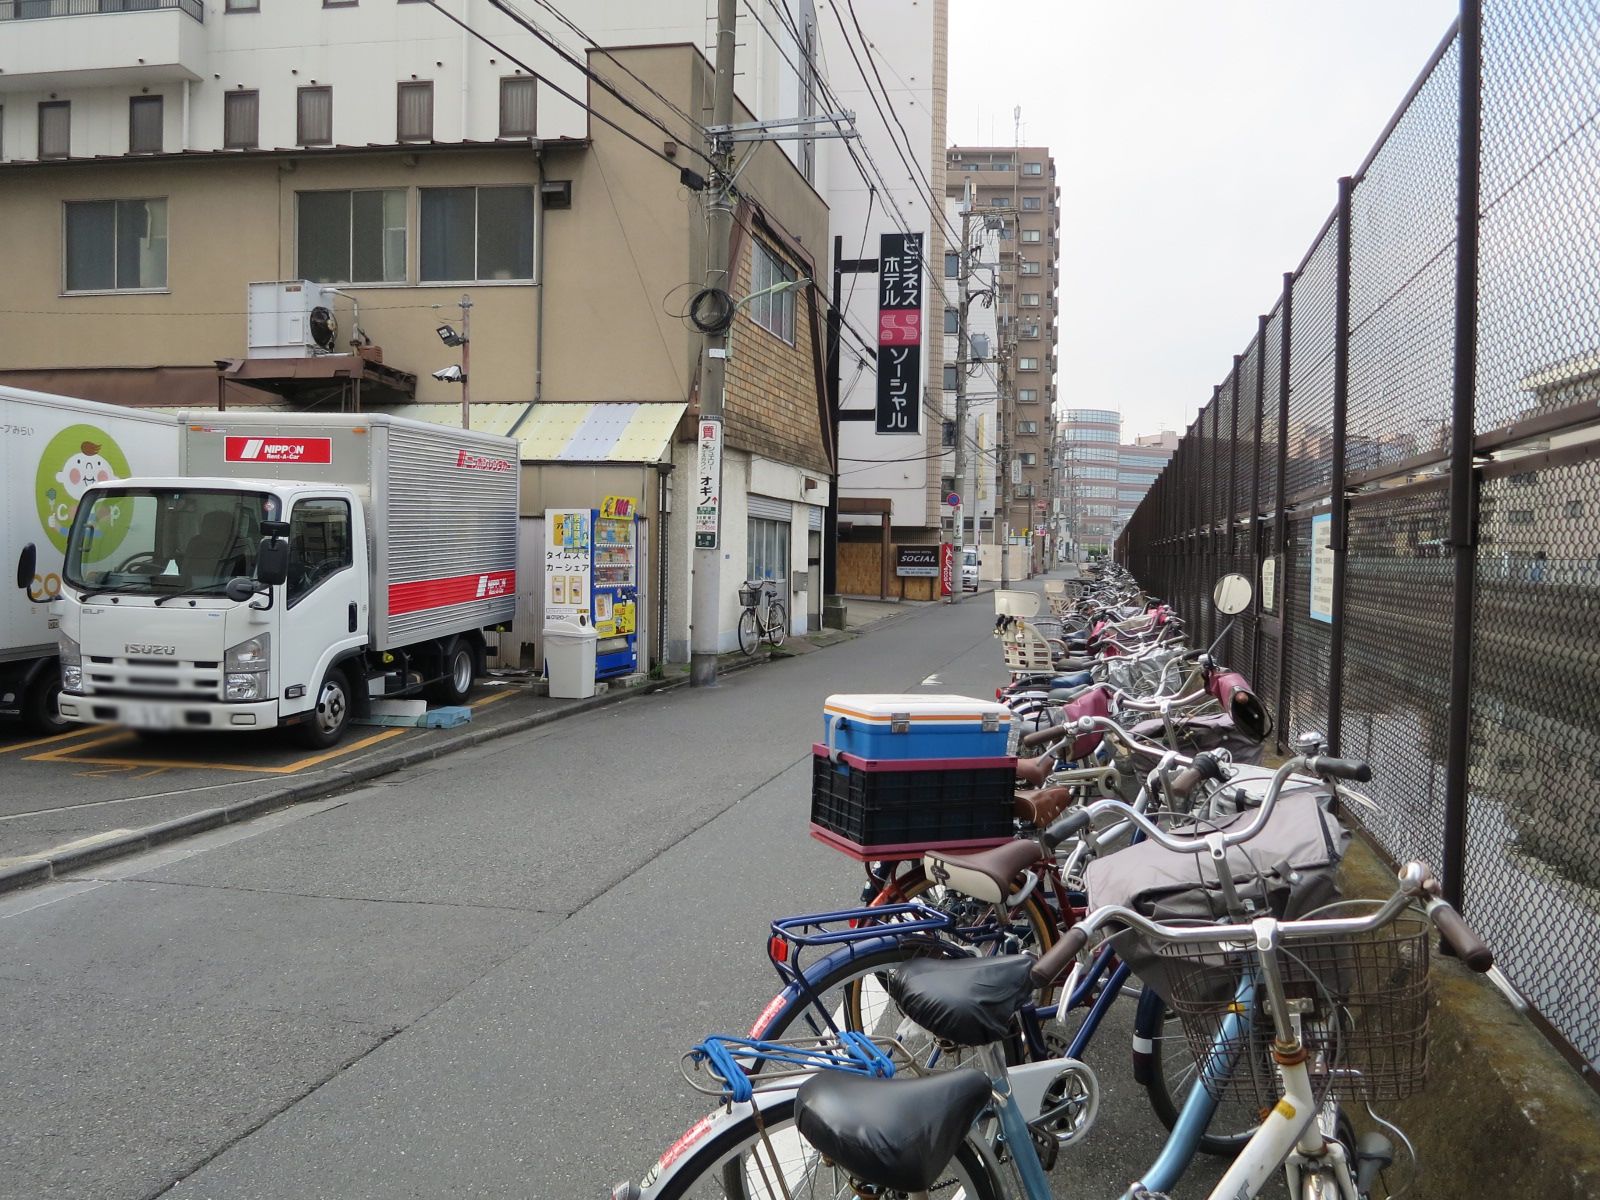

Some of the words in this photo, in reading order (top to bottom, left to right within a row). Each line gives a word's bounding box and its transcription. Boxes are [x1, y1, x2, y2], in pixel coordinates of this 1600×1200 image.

[902, 238, 919, 306] ビジネス
[883, 256, 901, 306] ホテル
[886, 348, 909, 428] ソーシャル
[703, 425, 715, 439] 質
[264, 444, 304, 454] NIPPON
[700, 476, 713, 506] オギノ
[900, 555, 936, 563] SOCIAL
[546, 564, 590, 572] カーシェア
[124, 644, 175, 656] ISUZU
